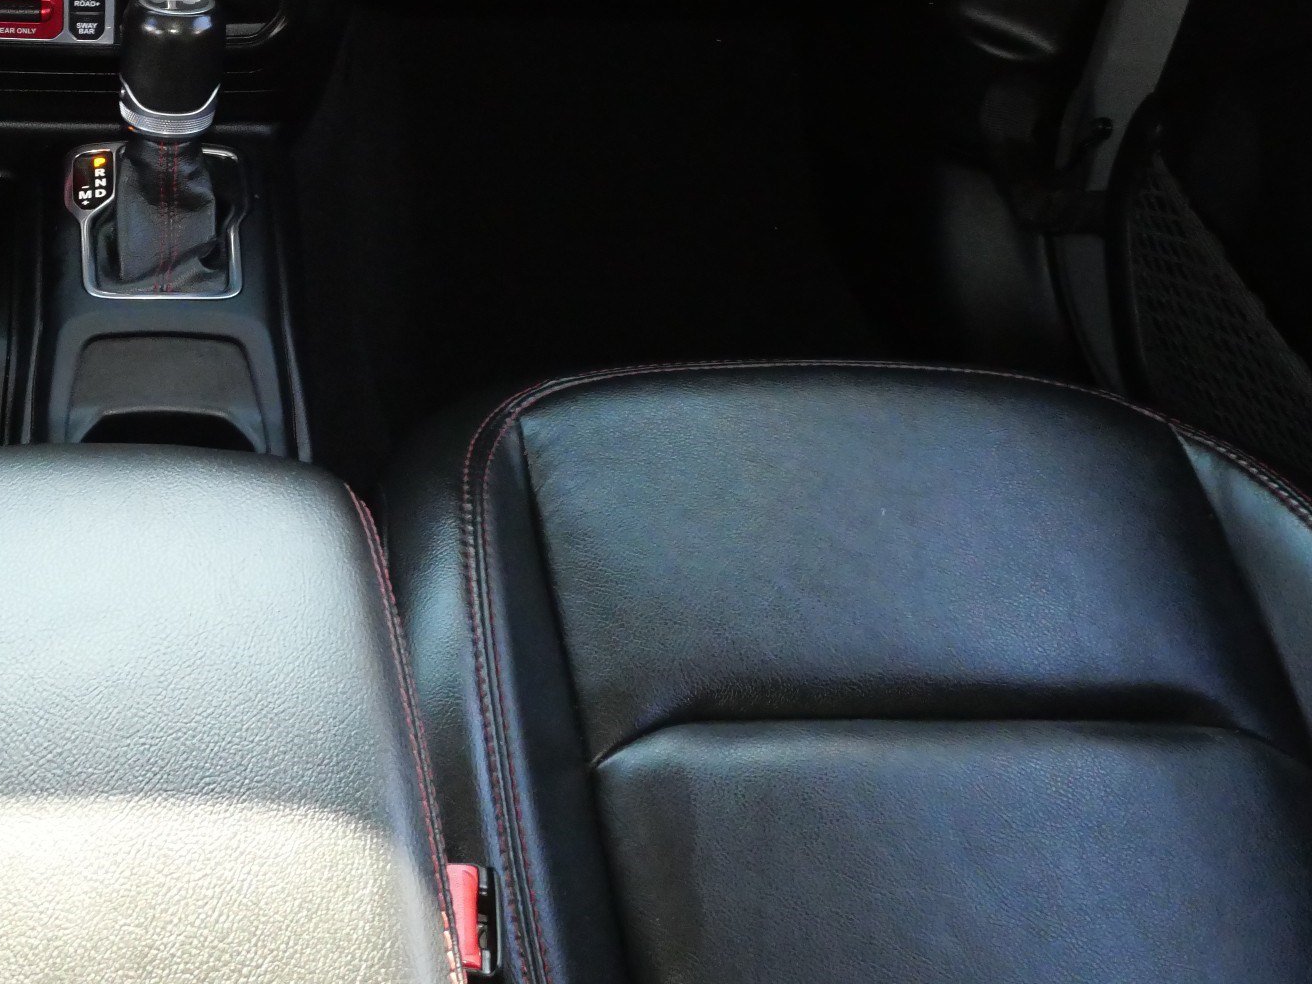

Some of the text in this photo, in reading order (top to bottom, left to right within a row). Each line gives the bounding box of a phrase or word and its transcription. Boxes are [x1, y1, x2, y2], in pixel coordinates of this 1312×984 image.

[73, 0, 101, 8] ROAD+
[16, 27, 37, 35] ONLY
[93, 157, 106, 168] P
[94, 168, 106, 177] R
[94, 178, 107, 187] N
[78, 190, 93, 200] M
[94, 188, 107, 198] D
